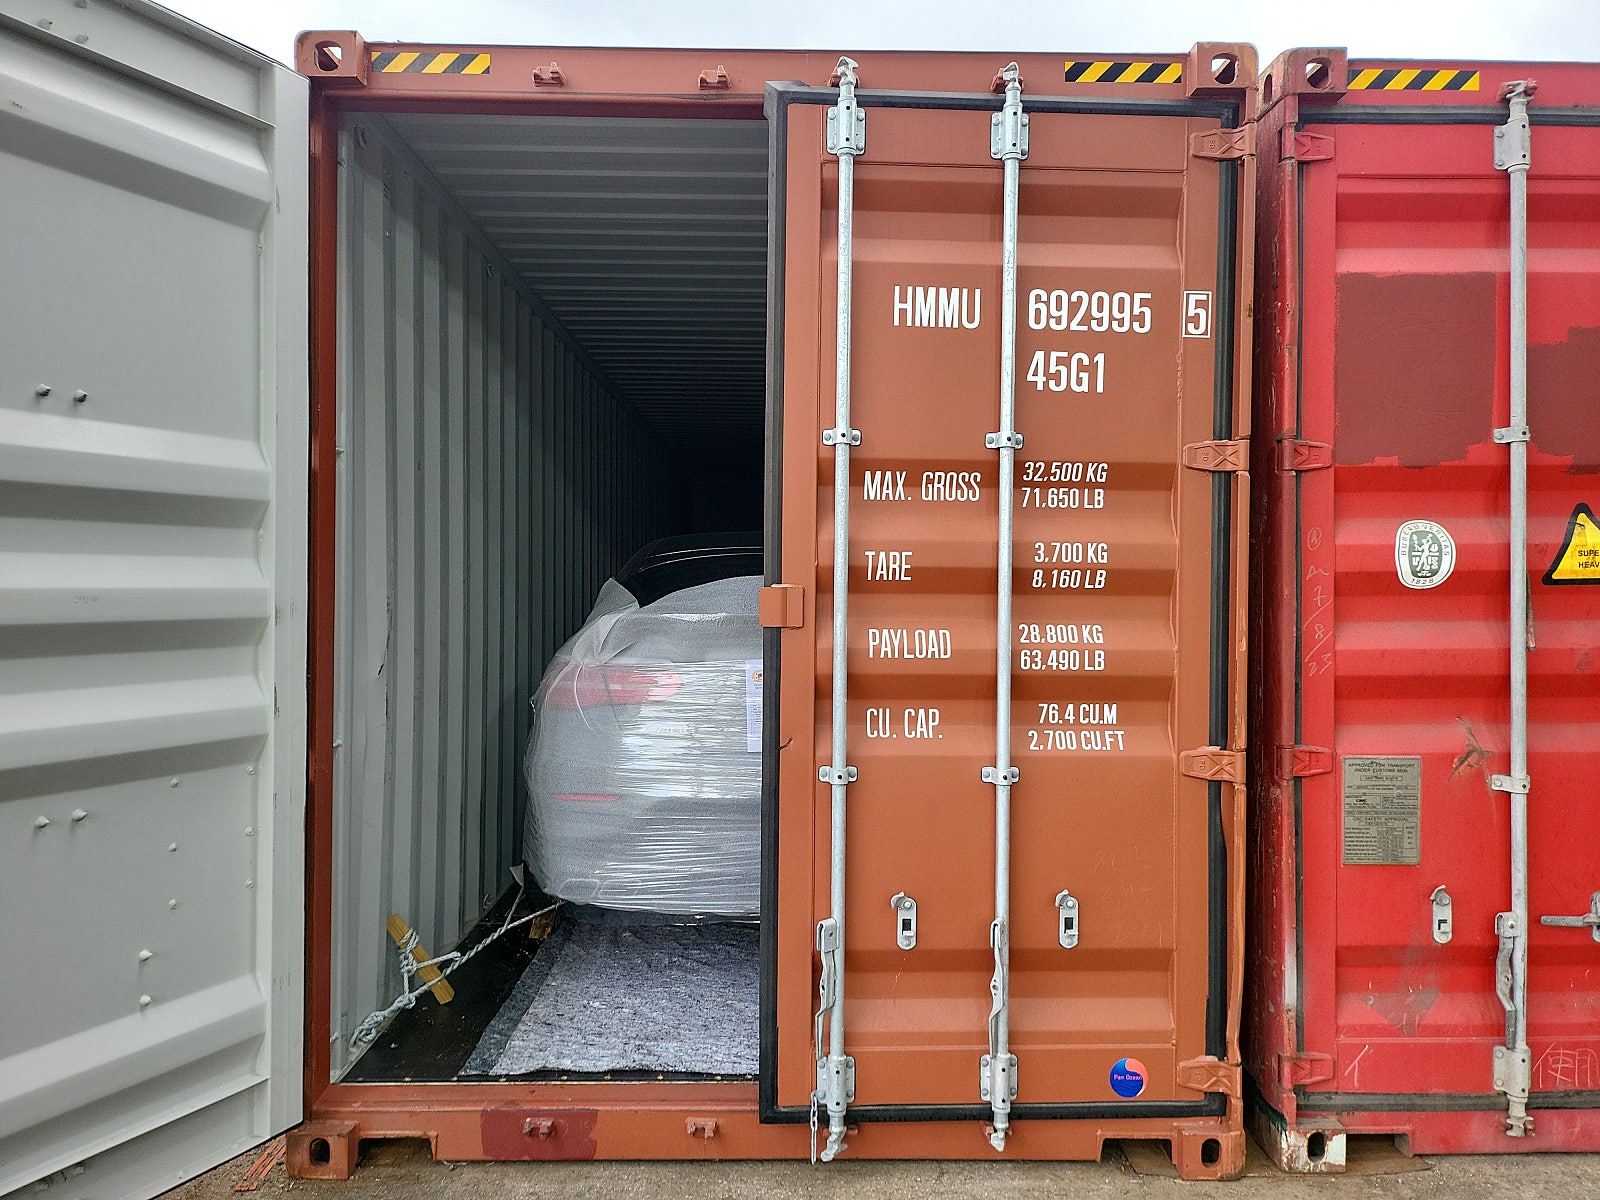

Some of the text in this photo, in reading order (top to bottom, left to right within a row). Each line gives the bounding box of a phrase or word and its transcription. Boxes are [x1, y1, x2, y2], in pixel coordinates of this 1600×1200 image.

[894, 286, 1207, 336] HMMU 692995 5
[1027, 351, 1104, 392] 45G1
[1086, 463, 1107, 482] KG
[864, 471, 980, 501] MAX. GROSS
[1084, 489, 1103, 508] LB
[1088, 543, 1107, 563] KG
[865, 551, 912, 580] TARE
[1085, 570, 1106, 588] LB
[869, 629, 950, 658] PAYLOAD
[1082, 625, 1104, 643] KG
[1085, 650, 1104, 670] LB
[867, 708, 942, 738] CU. CAP.
[1039, 704, 1116, 724] 76.4 CU.M
[1081, 731, 1124, 750] CU.FT
